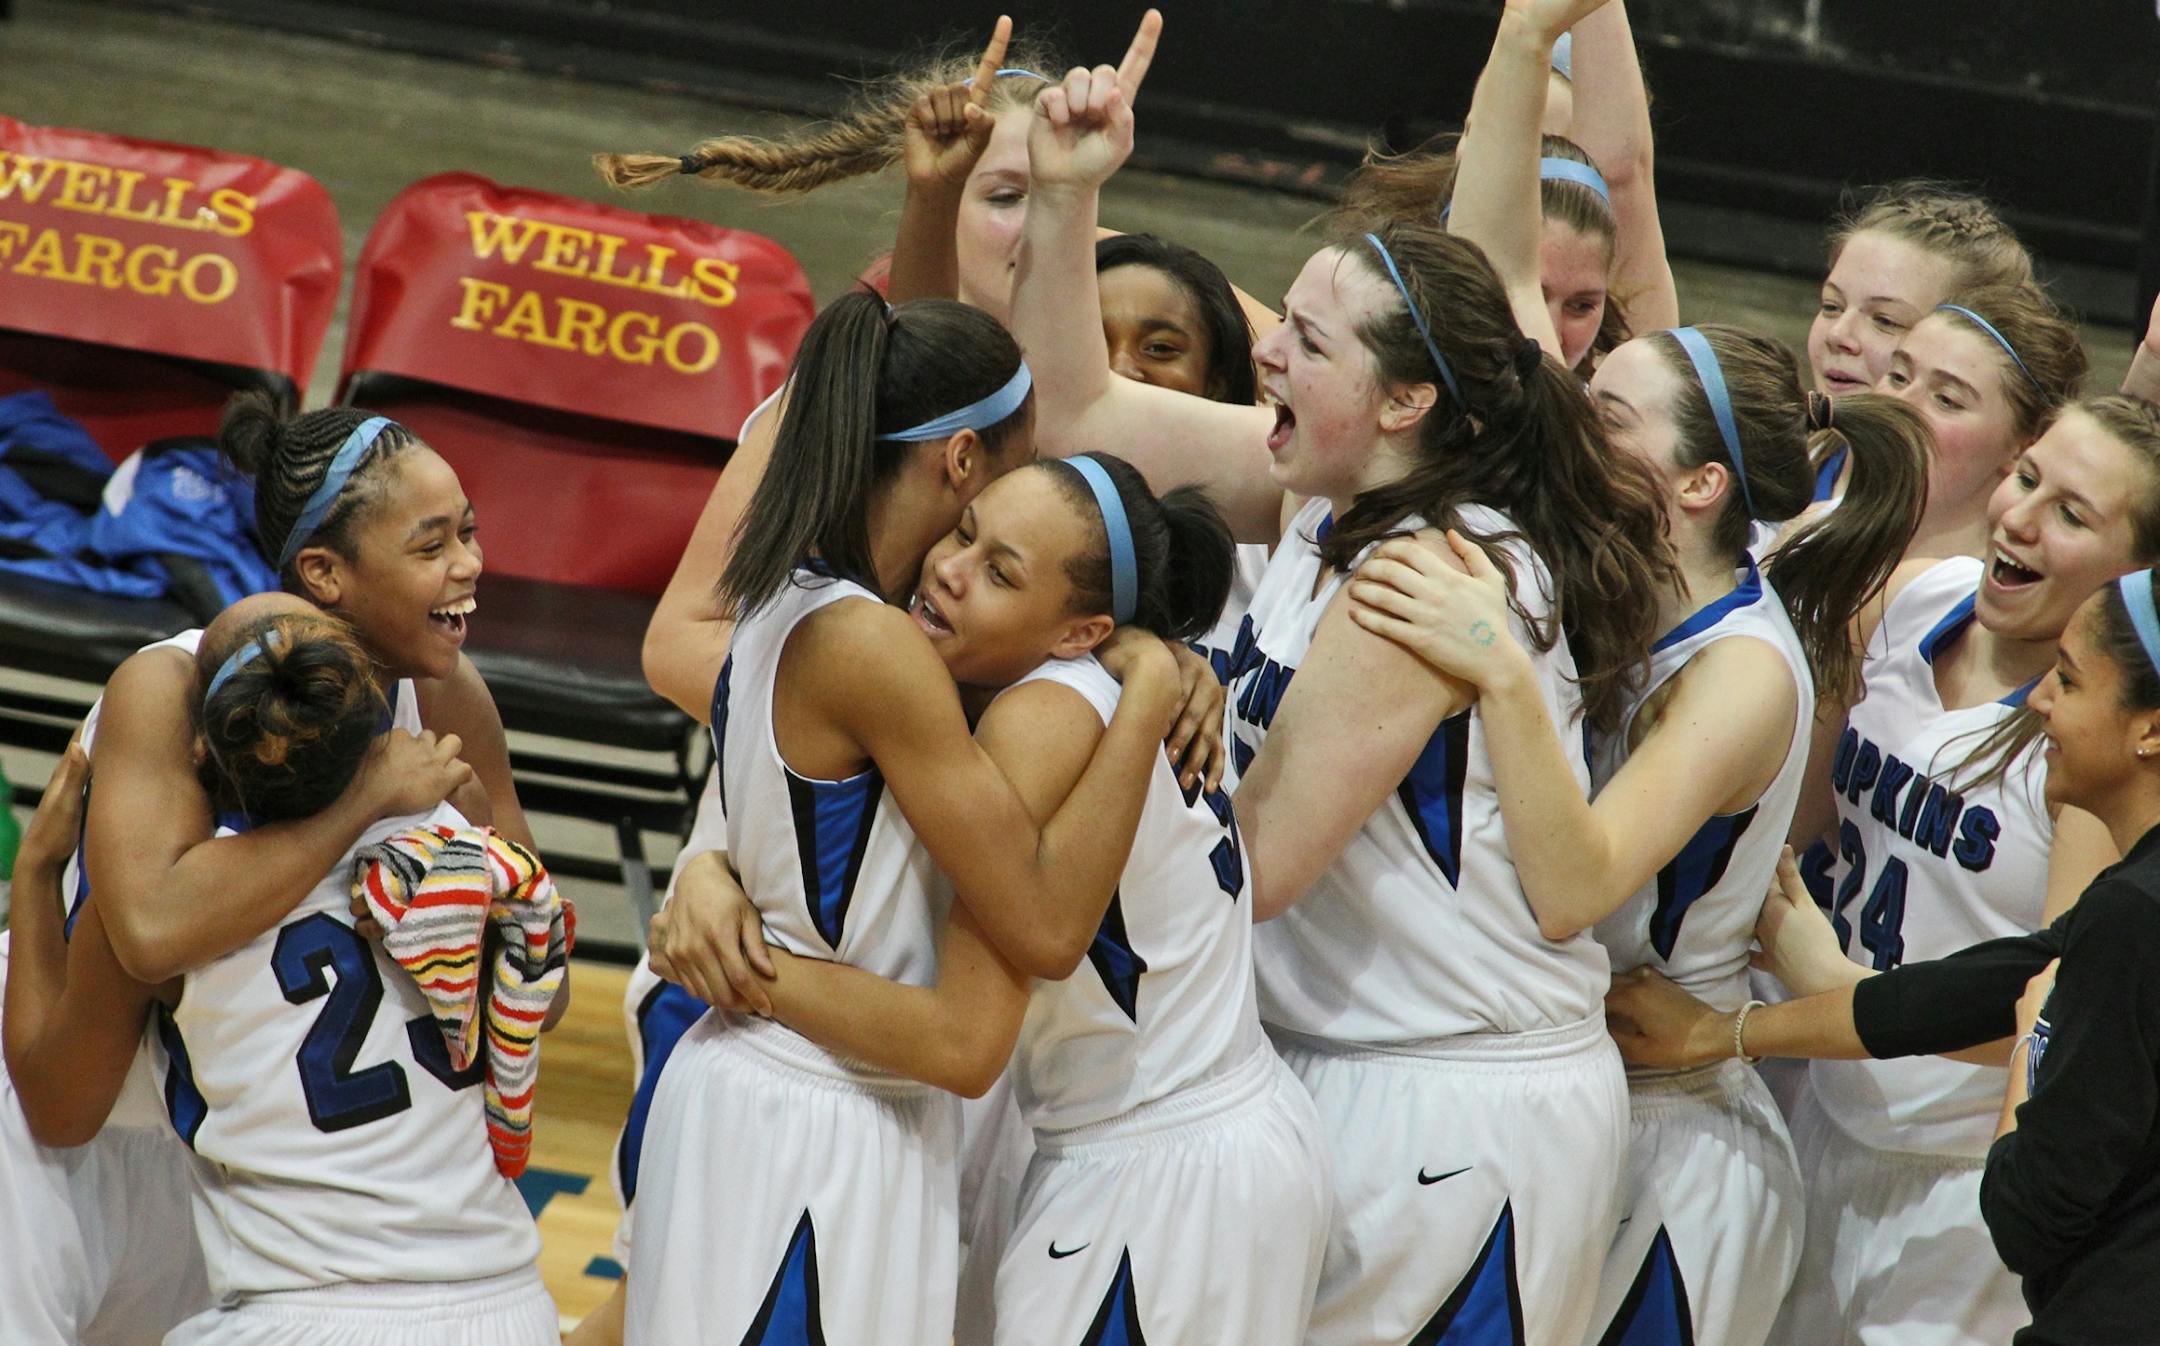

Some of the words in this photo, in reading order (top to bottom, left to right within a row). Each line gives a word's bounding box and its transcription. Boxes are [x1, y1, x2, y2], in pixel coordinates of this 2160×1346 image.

[0, 151, 257, 236] WELLS
[465, 210, 741, 308] WELLS
[450, 276, 721, 375] FARGO
[1832, 817, 1909, 973] 24
